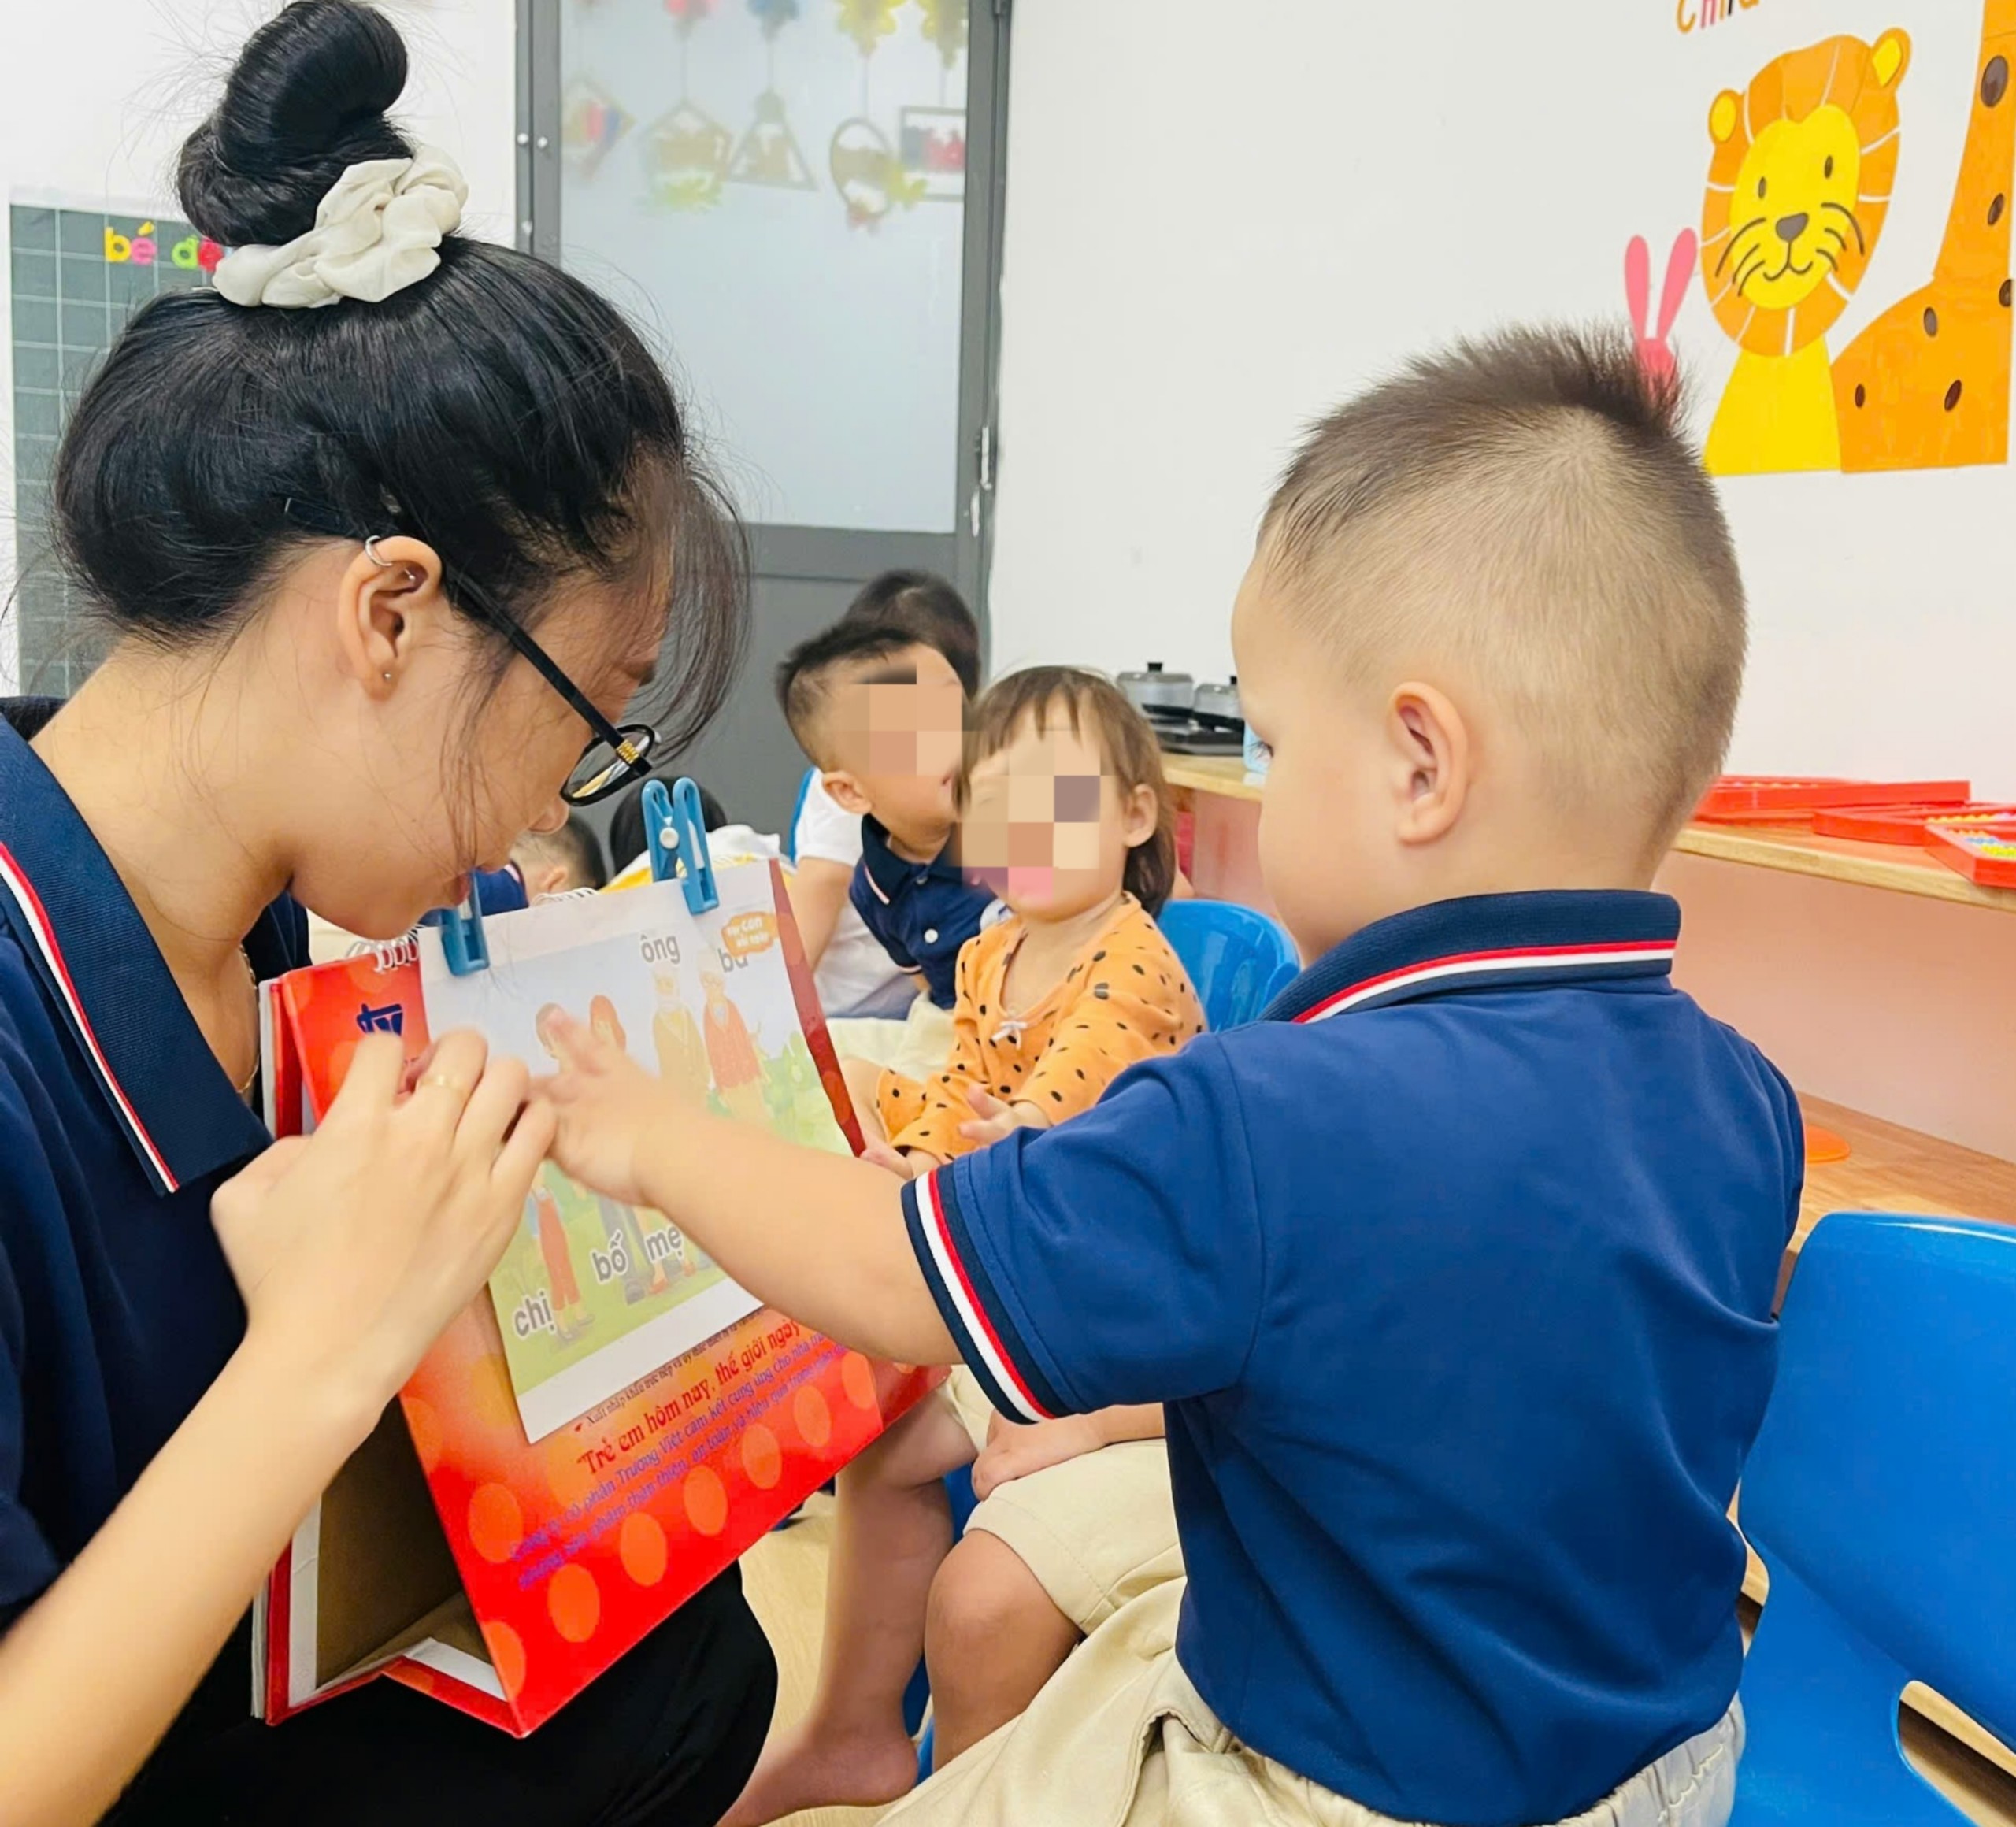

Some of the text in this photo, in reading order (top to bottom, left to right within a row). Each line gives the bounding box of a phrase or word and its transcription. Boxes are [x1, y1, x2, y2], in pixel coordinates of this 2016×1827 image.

[104, 220, 157, 265] bé
[640, 934, 681, 965] ông
[591, 1225, 682, 1282] bố mẹ
[514, 1290, 554, 1336] chị
[773, 1354, 791, 1373] cho
[619, 1425, 645, 1451] em
[643, 1400, 681, 1434] hôm
[714, 1349, 739, 1385] thế
[741, 1336, 767, 1372] giới
